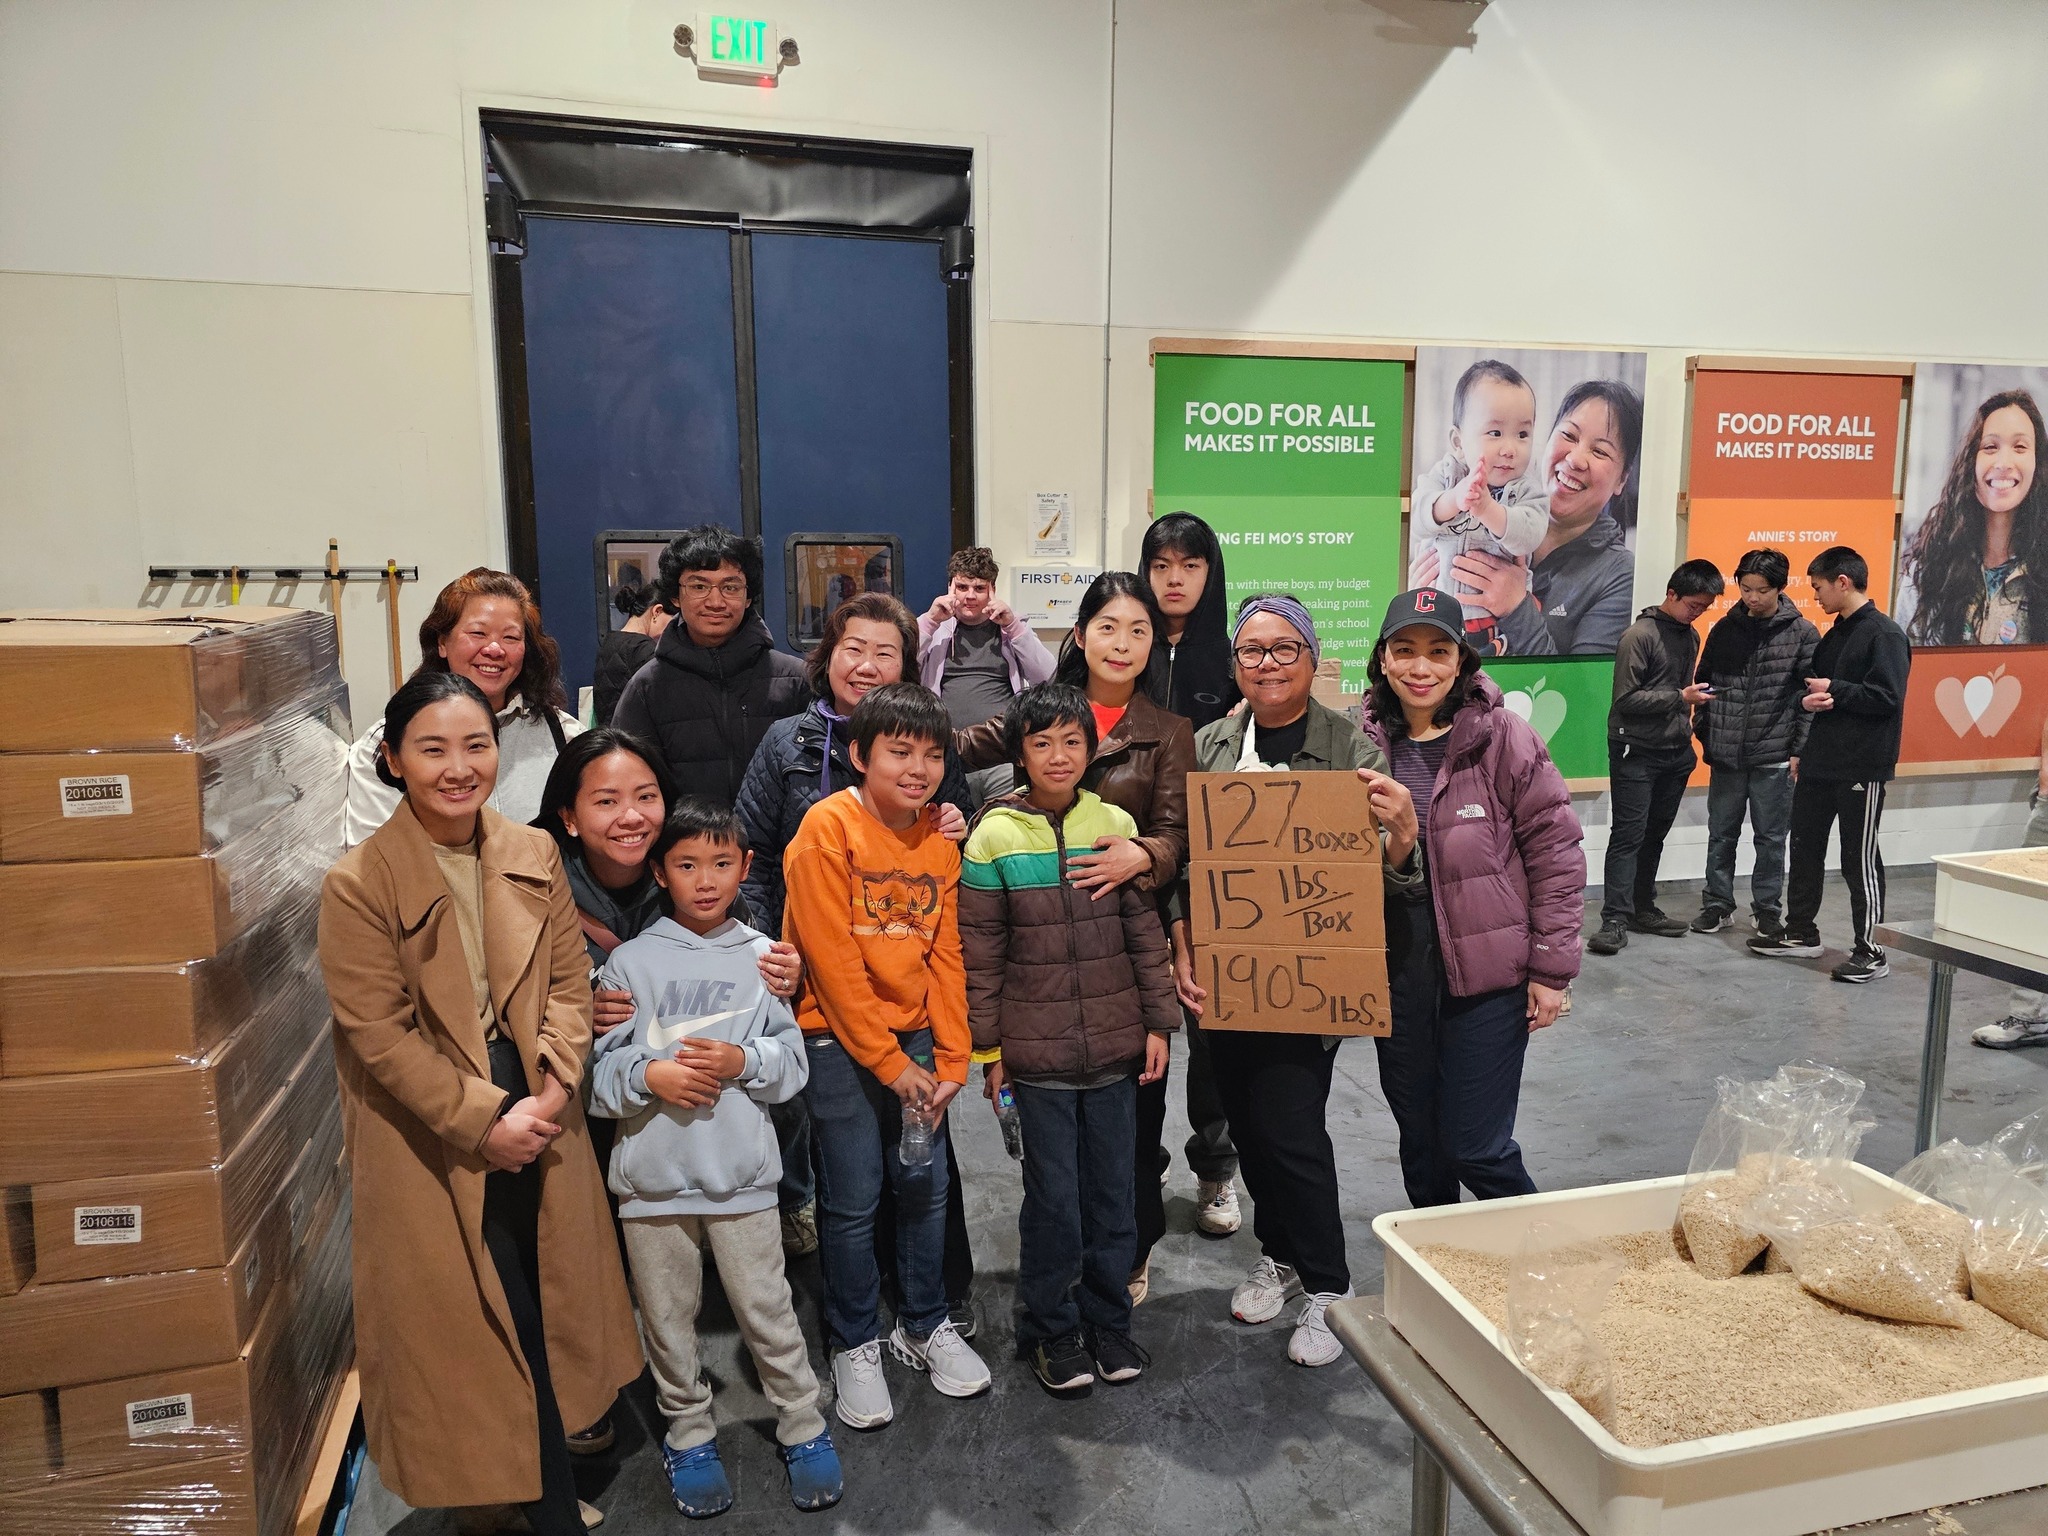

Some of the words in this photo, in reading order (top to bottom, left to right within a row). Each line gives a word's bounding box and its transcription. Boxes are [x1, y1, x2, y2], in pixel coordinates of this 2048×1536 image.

[711, 15, 767, 64] EXIT
[1185, 402, 1263, 426] FOOD
[1270, 403, 1322, 427] FOR
[1327, 405, 1376, 428] ALL
[1717, 413, 1783, 435] FOOD
[1787, 414, 1832, 436] FOR
[1835, 416, 1876, 437] ALL
[1184, 434, 1254, 452] MAKES
[1259, 434, 1278, 452] IT
[1283, 435, 1375, 453] POSSIBLE
[1716, 441, 1774, 458] MAKES
[1777, 442, 1794, 459] IT
[1797, 443, 1874, 460] POSSIBLE
[1215, 532, 1241, 545] NG
[1244, 532, 1264, 545] FEI
[1269, 532, 1304, 545] MO'S
[1308, 532, 1355, 545] STORY
[1747, 531, 1795, 542] ANNIE'S
[1798, 531, 1838, 542] STORY
[1021, 574, 1060, 584] FIRST
[1074, 574, 1097, 584] AID
[1236, 580, 1260, 590] with
[1262, 579, 1289, 590] three
[1291, 579, 1316, 592] boys,
[1318, 581, 1333, 592] my
[1336, 578, 1371, 591] budget
[1302, 598, 1340, 611] reaking
[1342, 599, 1372, 611] point.
[1415, 591, 1437, 613] C
[1313, 619, 1334, 629] on's
[1336, 618, 1370, 628] school
[1346, 637, 1370, 648] with
[65, 785, 122, 799] 20106115
[1201, 780, 1301, 850] 127
[1293, 827, 1375, 856] Boxes
[1207, 868, 1263, 931] 15
[1303, 910, 1353, 938] Box
[657, 979, 737, 1018] NIKE
[80, 1215, 135, 1228] 20106115
[132, 1404, 186, 1423] 20106115
[134, 1401, 163, 1409] BROWN
